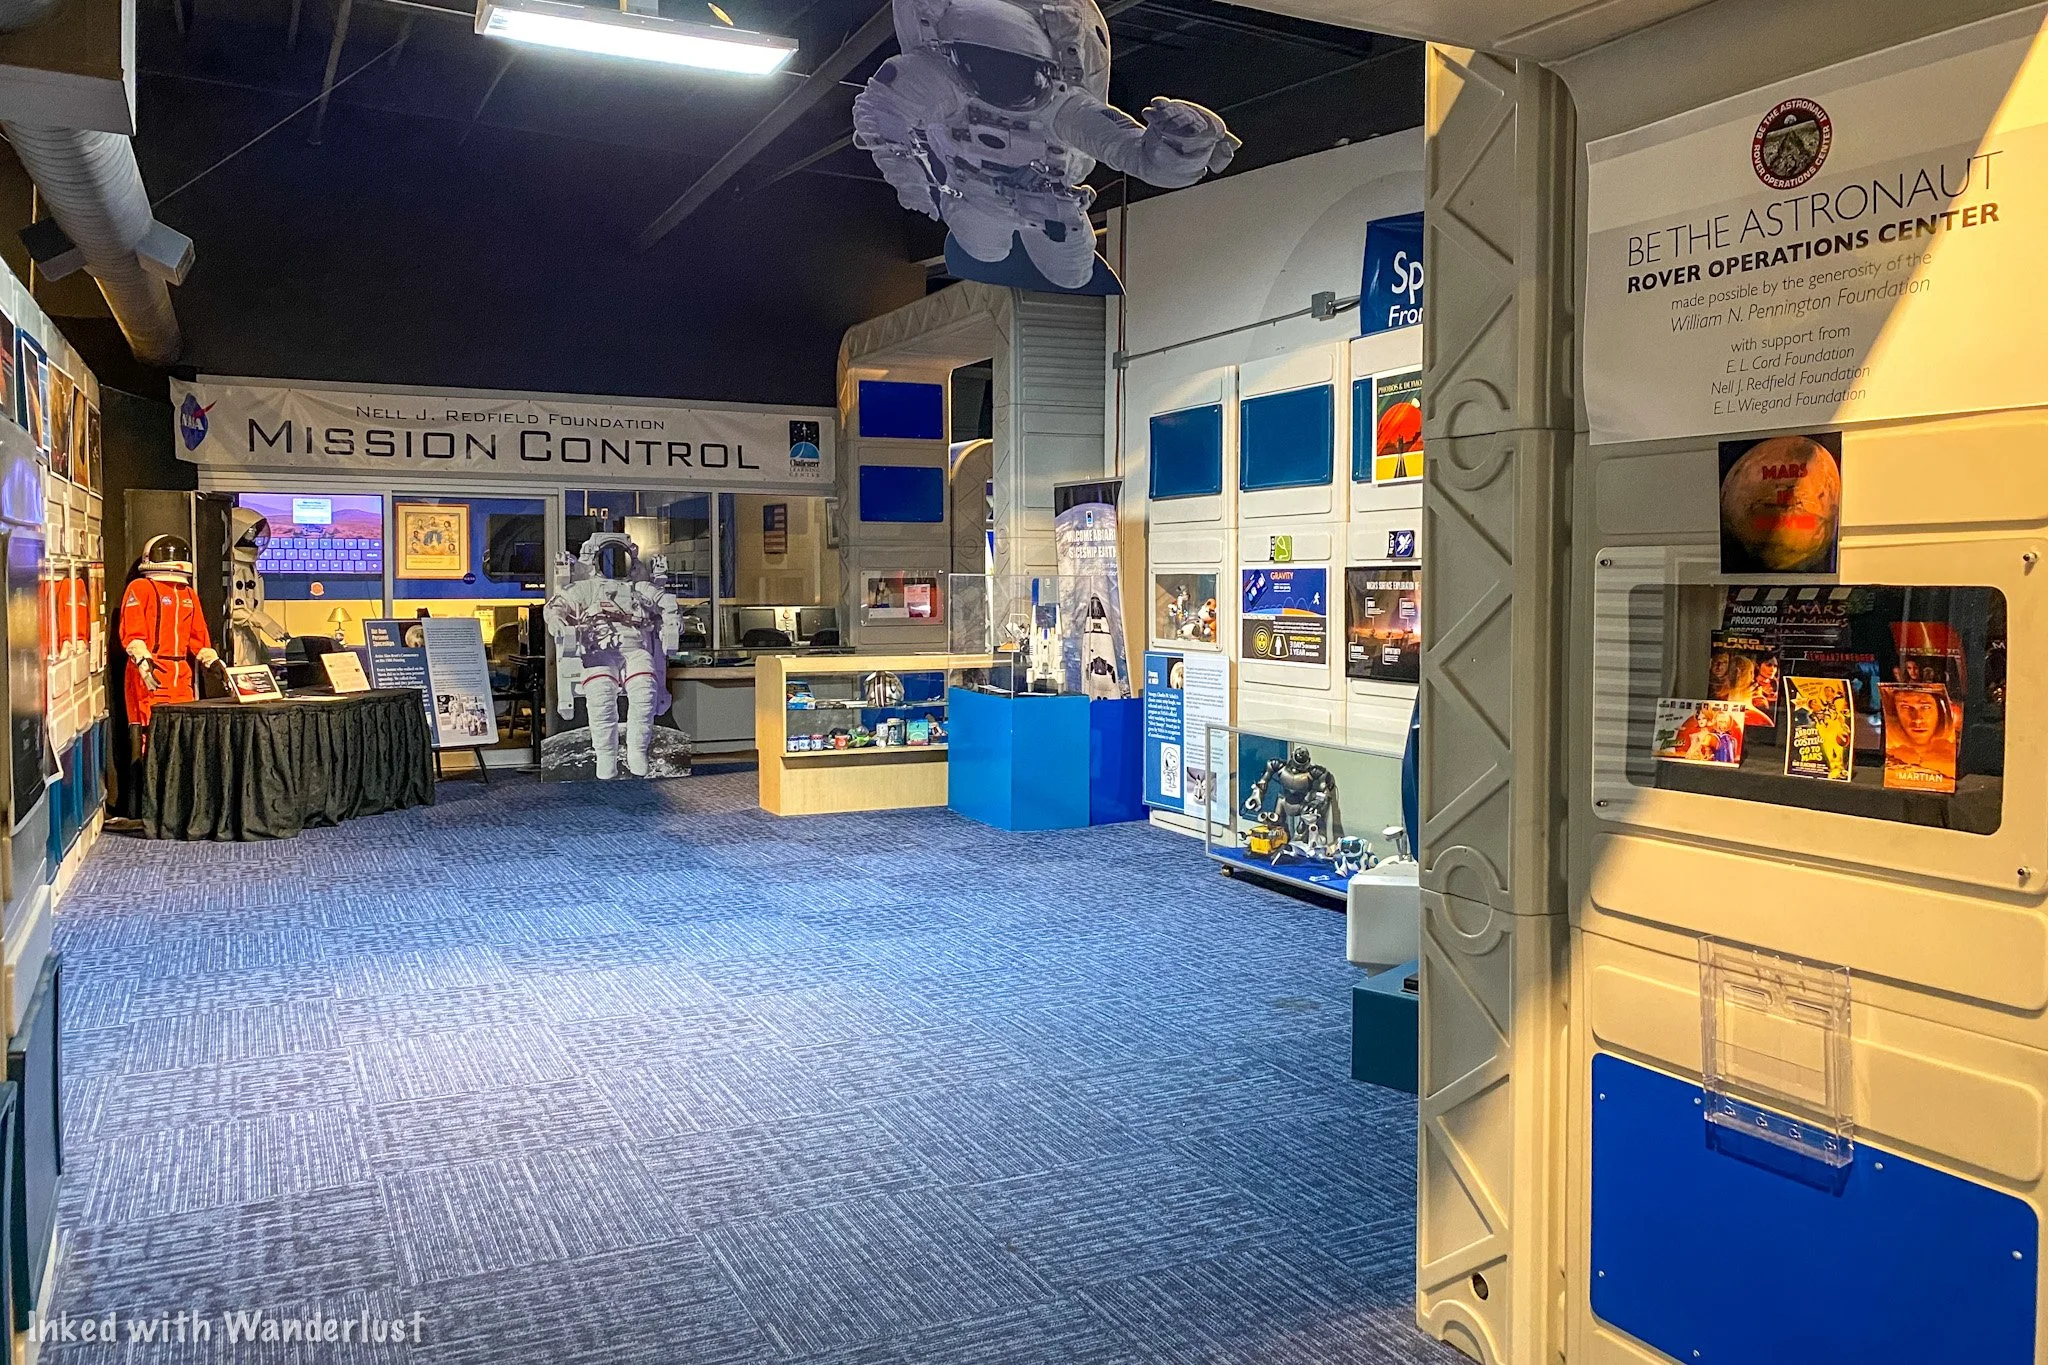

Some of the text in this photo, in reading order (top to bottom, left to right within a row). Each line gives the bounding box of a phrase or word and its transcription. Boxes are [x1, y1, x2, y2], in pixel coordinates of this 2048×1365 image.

[1756, 100, 1827, 139] BE THE ASTRONAUT
[1754, 125, 1830, 188] ROVER OPERATIONS CENTER
[1628, 151, 2003, 266] BE THE ASTRONAUT
[1628, 202, 1999, 293] ROVER OPERATIONS CENTER
[1392, 251, 1424, 304] Sp
[1671, 252, 1932, 310] made possible by the generosity of the
[1671, 278, 1930, 332] William N. Pennington Foundation
[1731, 326, 1850, 352] with support from
[1752, 354, 1780, 370] Cord
[1784, 346, 1855, 366] Foundation
[1378, 383, 1398, 394] PHOBOS
[1404, 379, 1422, 389] DEIMO
[1711, 365, 1870, 396] Nell J. Redfield Foundation
[1738, 395, 1792, 415] Wiegand
[1795, 387, 1866, 406] Foundation
[356, 406, 665, 431] NELL J. REDFIELD FOUNDATION
[249, 418, 760, 470] MISSION CONTROL
[1762, 463, 1808, 480] MARS
[1270, 571, 1294, 580] GRAVITY
[1733, 605, 1777, 614] HOLLYWOOD
[1787, 603, 1847, 616] MARS
[1730, 616, 1777, 625] PRODUCTION
[1803, 616, 1849, 628] MOVIES
[1712, 641, 1776, 651] PLANET
[1727, 637, 1760, 645] RED
[1794, 728, 1818, 738] ABBOTT
[1794, 736, 1825, 748] COSTELLO
[1799, 747, 1810, 755] GO
[1801, 753, 1823, 761] MARS
[1898, 771, 1943, 783] MARTIAN
